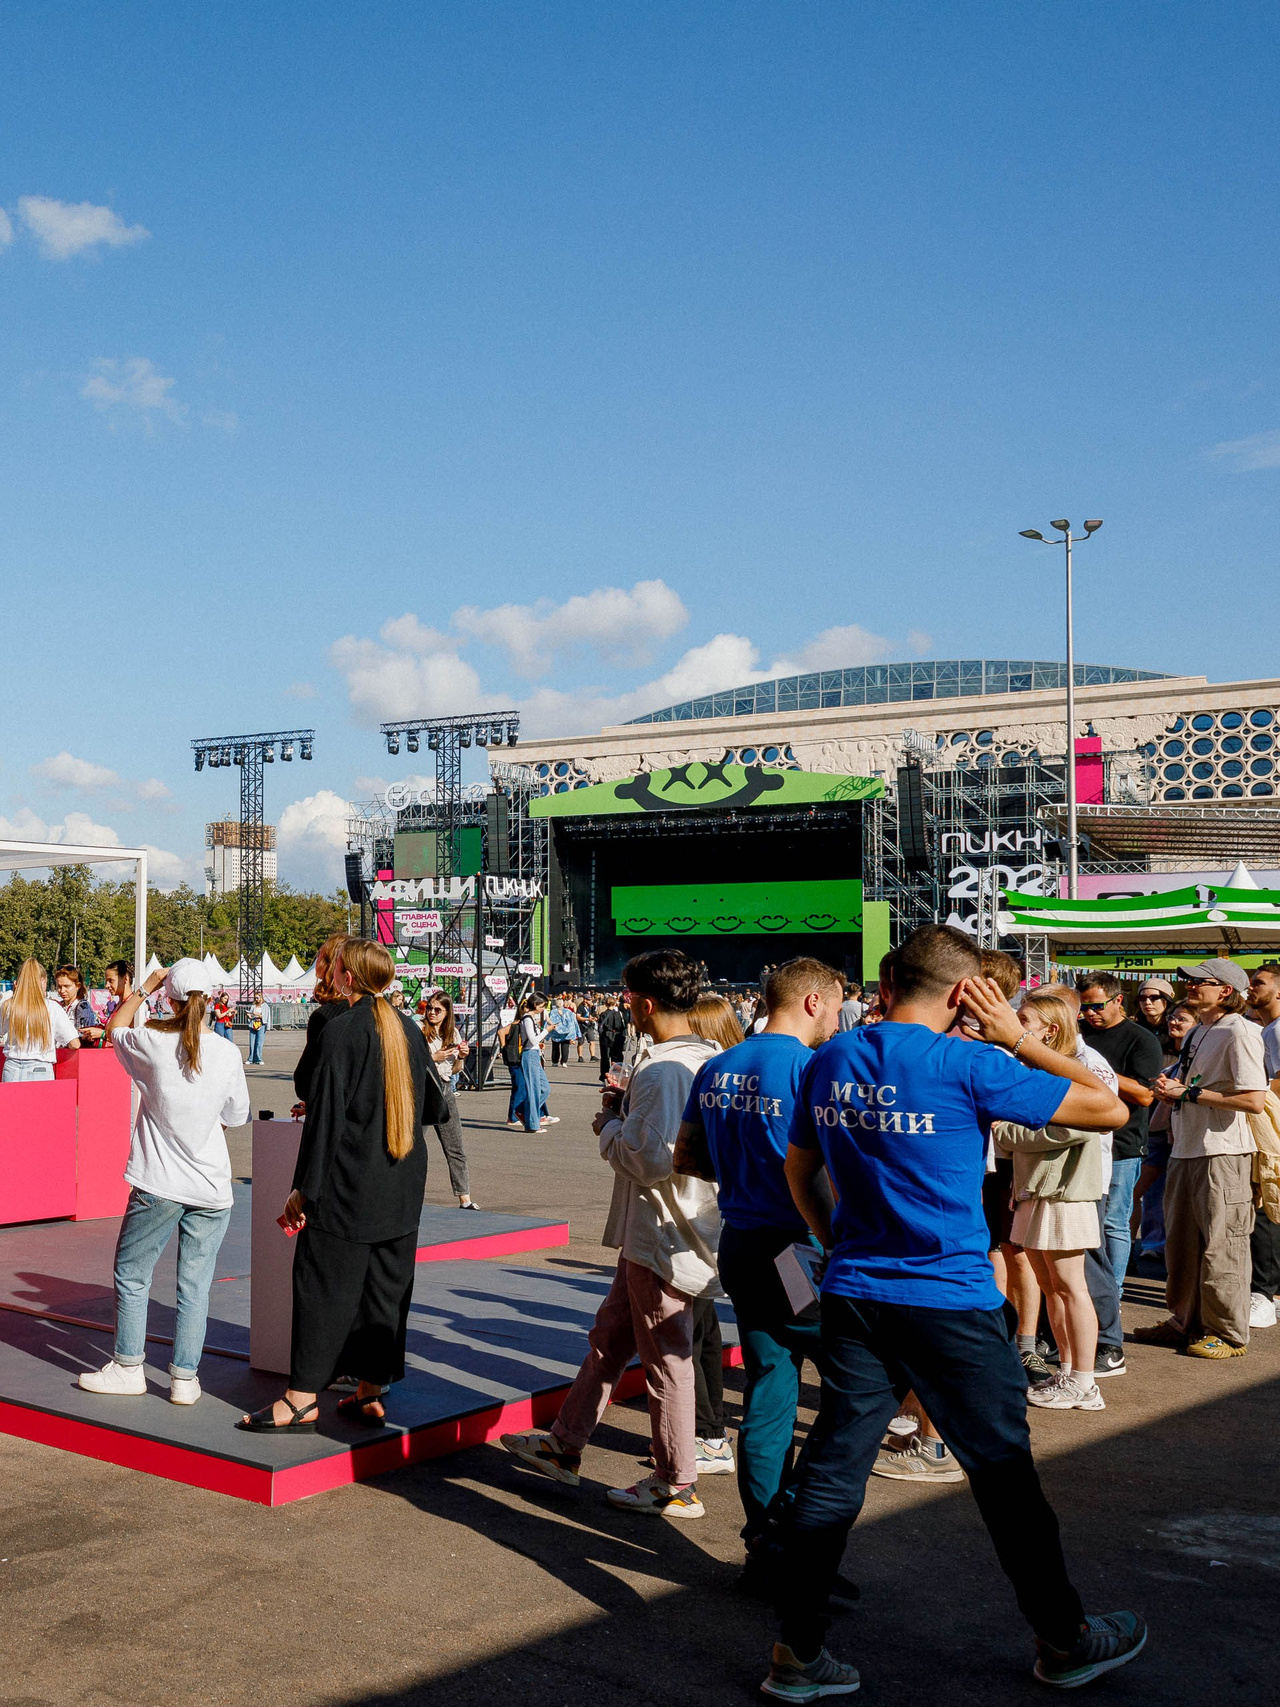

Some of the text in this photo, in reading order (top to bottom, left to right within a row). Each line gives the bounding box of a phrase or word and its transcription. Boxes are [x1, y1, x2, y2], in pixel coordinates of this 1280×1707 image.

[941, 829, 1042, 854] ПИКН
[947, 863, 1057, 898] 202
[411, 921, 438, 929] СЦЕНА
[435, 966, 464, 974] ВЫХОД
[710, 1072, 760, 1092] МЧС
[829, 1081, 897, 1107] МЧС
[699, 1092, 783, 1117] РОССИИ
[814, 1105, 937, 1134] РОССИИ
